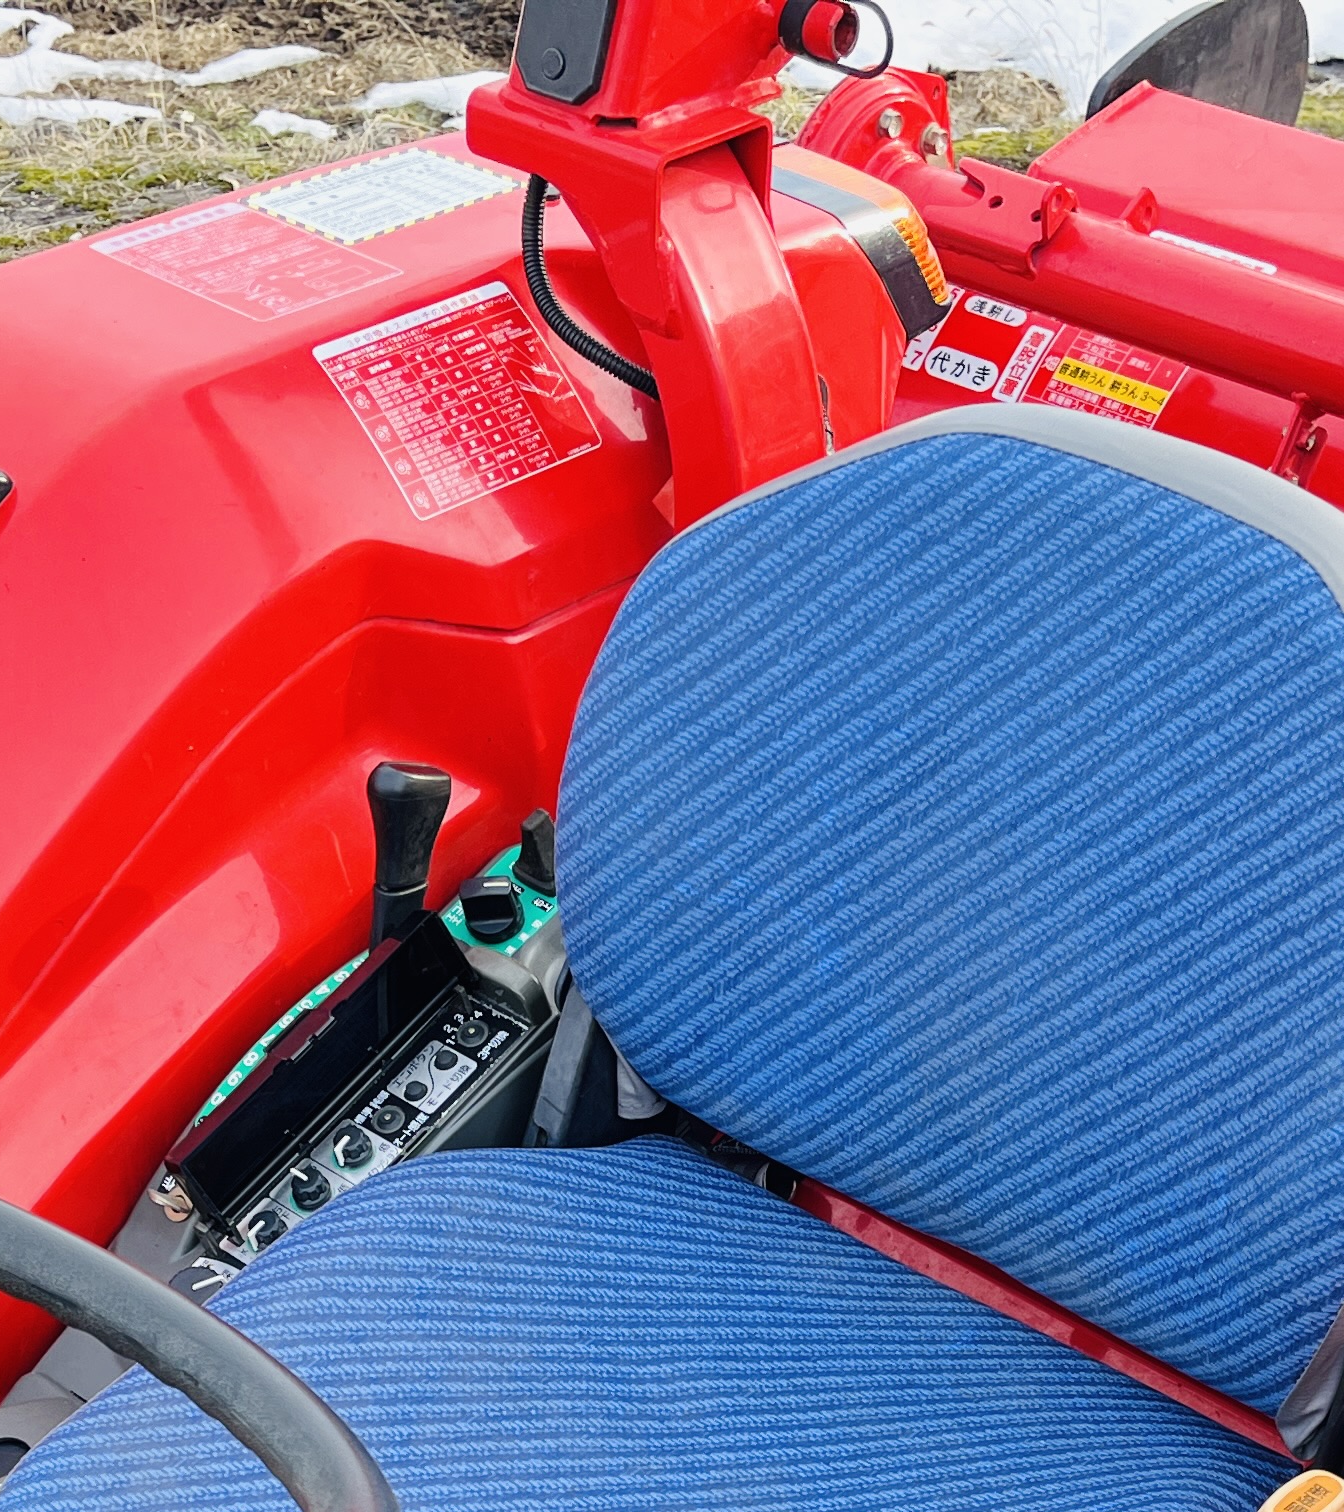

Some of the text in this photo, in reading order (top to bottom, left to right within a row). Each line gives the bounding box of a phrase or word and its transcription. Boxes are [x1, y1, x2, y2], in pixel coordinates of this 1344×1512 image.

[910, 350, 923, 365] 7
[926, 349, 994, 387] 代かき
[1000, 331, 1048, 397] 着脱位置
[1057, 362, 1109, 387] 普通耕うん
[1107, 379, 1142, 399] 耕うん
[315, 984, 331, 996] 4
[334, 970, 350, 983] 3
[243, 1051, 259, 1067] 8
[391, 1045, 434, 1089] エコボタン
[427, 1064, 471, 1107] モード切換
